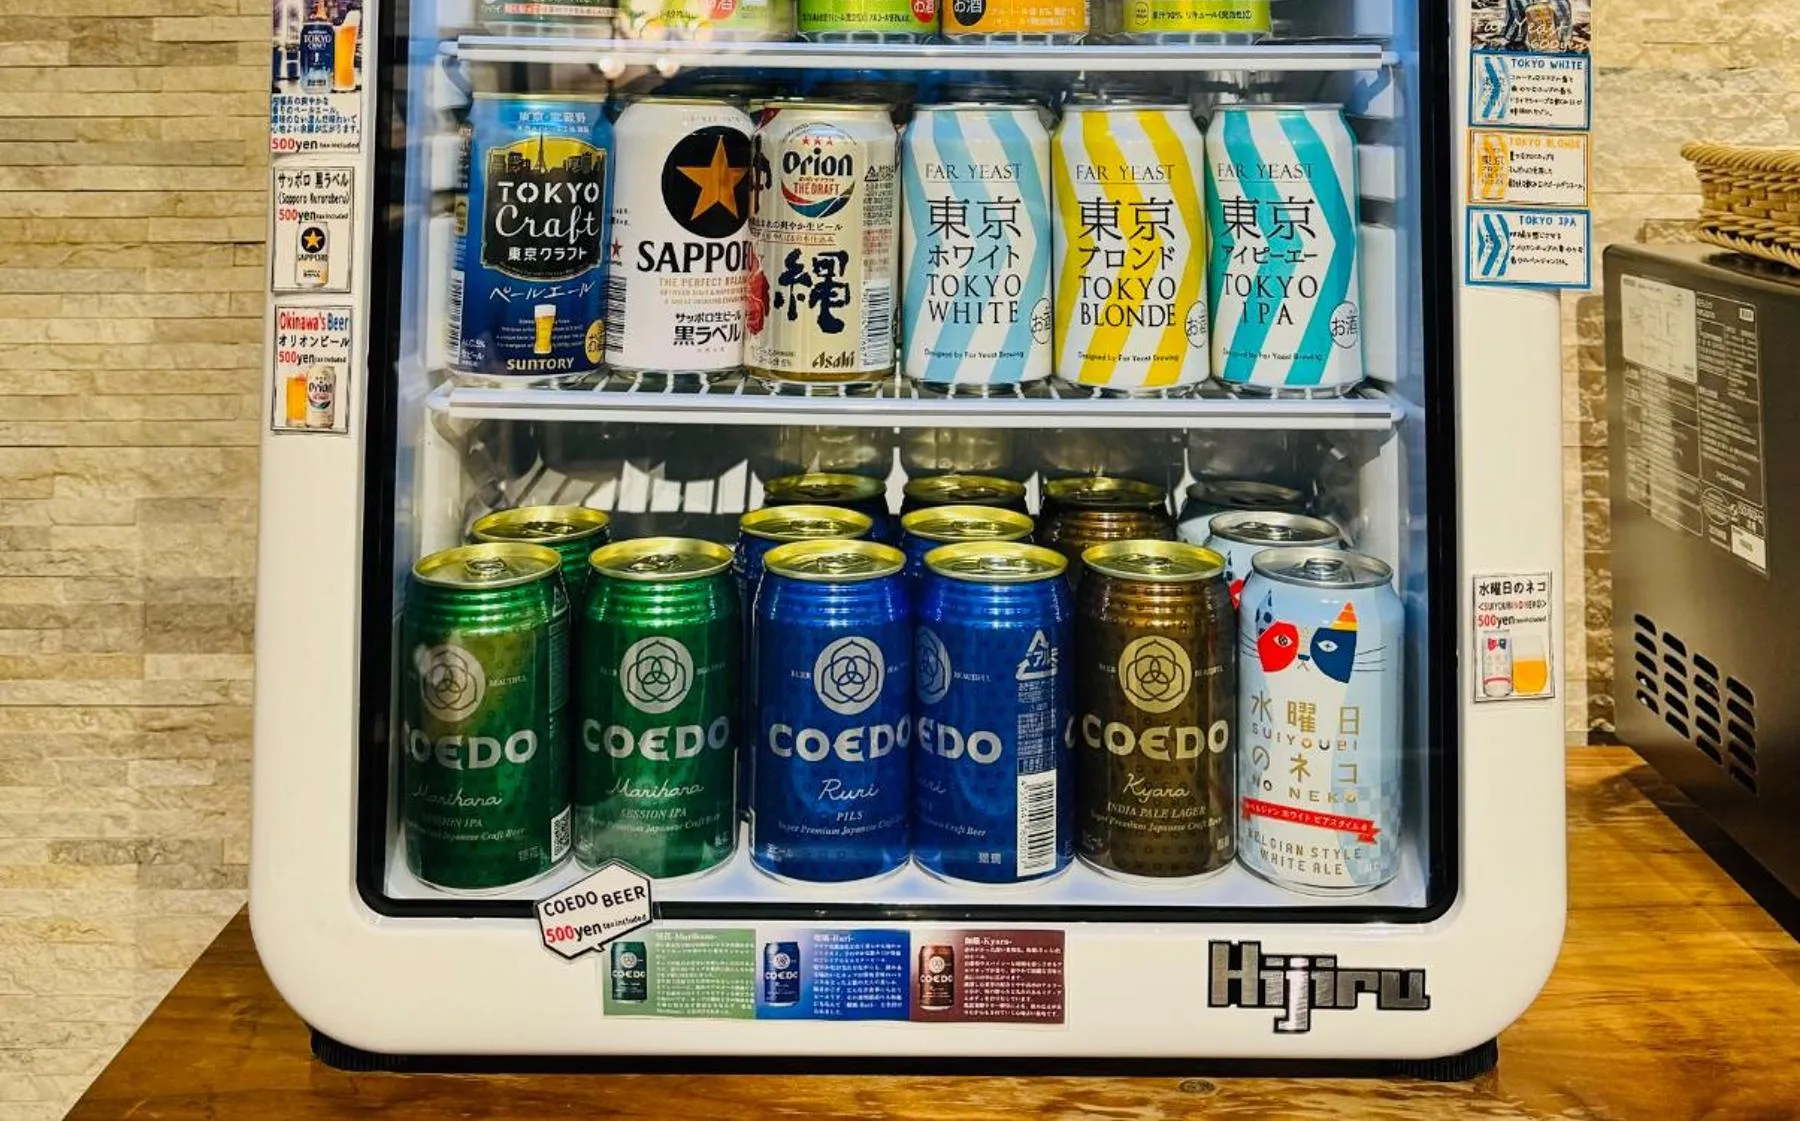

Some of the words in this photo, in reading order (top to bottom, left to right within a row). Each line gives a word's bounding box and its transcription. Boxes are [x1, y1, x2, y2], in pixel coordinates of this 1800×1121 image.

[1511, 58, 1546, 69] TOKYO
[1549, 59, 1583, 71] WHITE
[271, 138, 318, 154] 500yen
[782, 146, 853, 177] Orion
[924, 163, 960, 180] FAR
[967, 163, 1023, 180] YEAST
[1076, 164, 1110, 181] FAR
[1119, 163, 1176, 181] YEAST
[1217, 162, 1248, 180] FAR
[1256, 162, 1315, 180] YEAST
[278, 171, 311, 189] サッポロ
[315, 171, 349, 189] 黒ラベル
[497, 181, 600, 204] TOKYO
[278, 208, 316, 224] 500yen
[495, 203, 600, 246] Craft
[926, 195, 1023, 241] 東京
[1077, 196, 1176, 242] 東京
[1219, 195, 1317, 241] 東京
[1519, 215, 1553, 226] TOKYO
[507, 246, 588, 262] 東京クラフト
[927, 244, 1020, 269] ホワイト
[1077, 246, 1176, 271] ブロンド
[1220, 244, 1319, 266] アイピーエー
[489, 282, 596, 304] ペールエール
[926, 273, 1022, 298] TOKYO
[1077, 275, 1176, 301] TOKYO
[1222, 272, 1319, 299] TOKYO
[280, 311, 326, 331] Okinawa's
[327, 312, 349, 331] Beer
[675, 310, 741, 324] サッポロ生ビール
[928, 299, 1019, 324] WHITE
[1080, 303, 1176, 327] BLONDE
[1242, 301, 1294, 326] IPA
[278, 334, 351, 347] オリオンビール
[672, 324, 742, 346] 黒ラベル
[278, 350, 315, 366] 500yen
[506, 357, 575, 371] SUNTORY
[811, 350, 856, 370] Asahi
[1478, 580, 1547, 596] 水曜日のネコ
[1478, 614, 1516, 628] 500yen
[1250, 690, 1361, 736] 水曜日
[582, 715, 730, 762] COEDO
[768, 713, 911, 762] COEDO
[1081, 713, 1230, 762] COEDO
[1252, 744, 1358, 784] のネコ
[605, 776, 705, 801] Marihana
[816, 777, 880, 802] Ruri
[1122, 771, 1191, 805] Kyara
[836, 810, 864, 822] PILS
[1139, 808, 1169, 820] PALE
[1170, 806, 1208, 820] LAGER
[1312, 862, 1344, 876] ALE
[543, 890, 598, 917] COEDO
[601, 885, 646, 909] BEER
[545, 923, 603, 943] 500yen
[1207, 939, 1431, 1034] Hijiru
